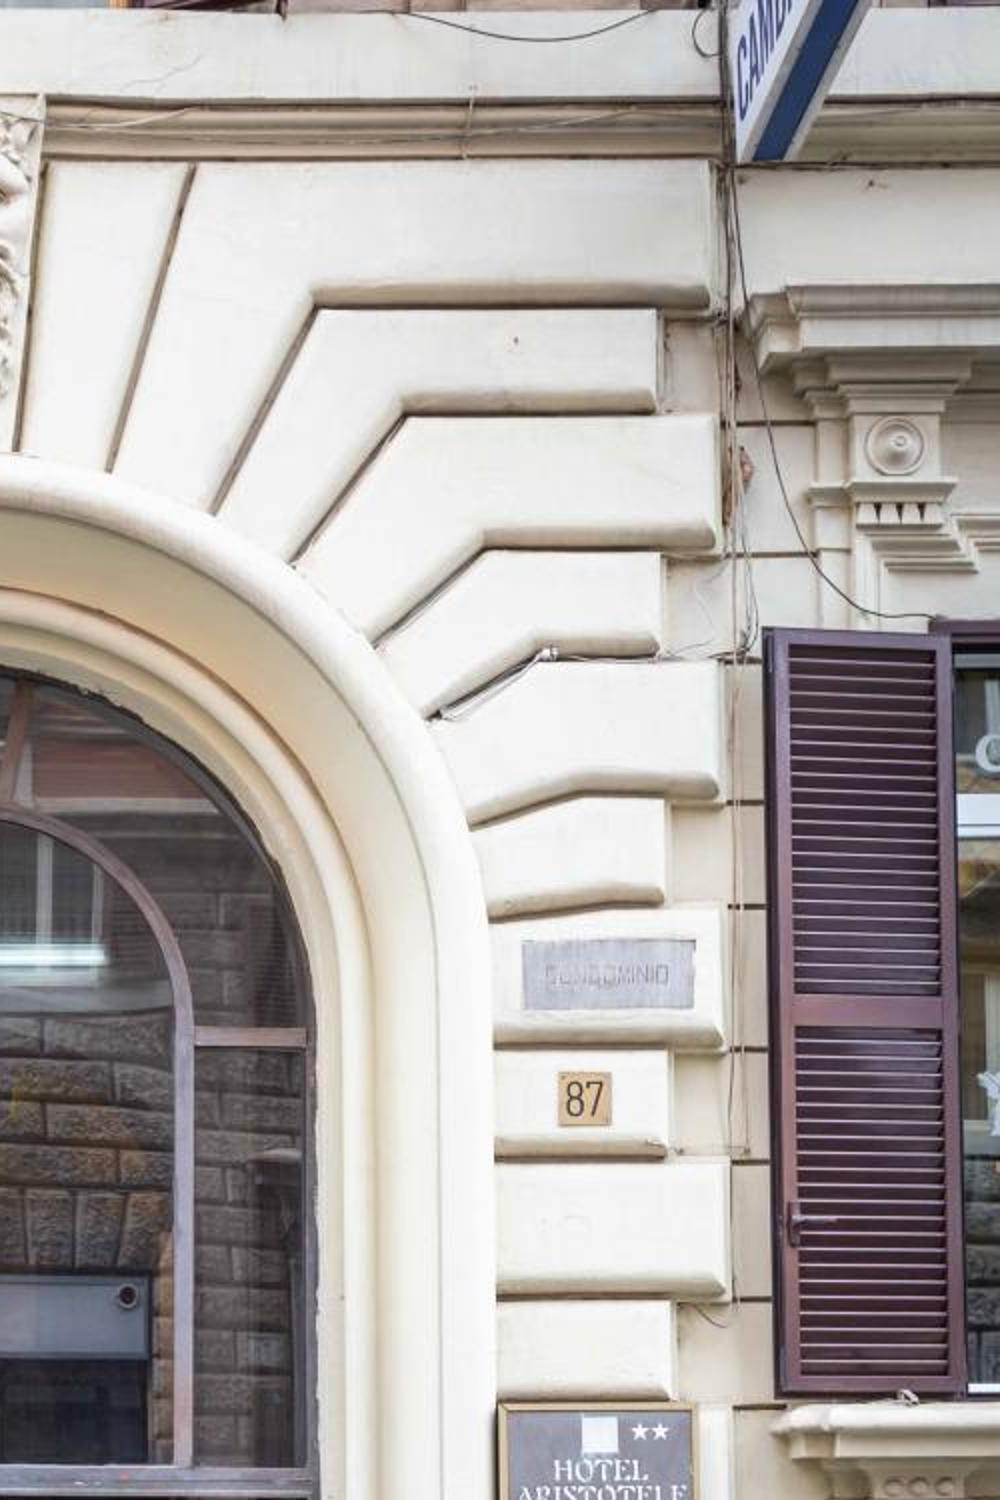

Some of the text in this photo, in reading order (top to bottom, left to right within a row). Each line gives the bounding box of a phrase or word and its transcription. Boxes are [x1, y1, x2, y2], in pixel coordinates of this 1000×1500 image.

[737, 0, 792, 121] CAM
[566, 1081, 603, 1117] 87
[553, 1459, 649, 1481] HOTEL
